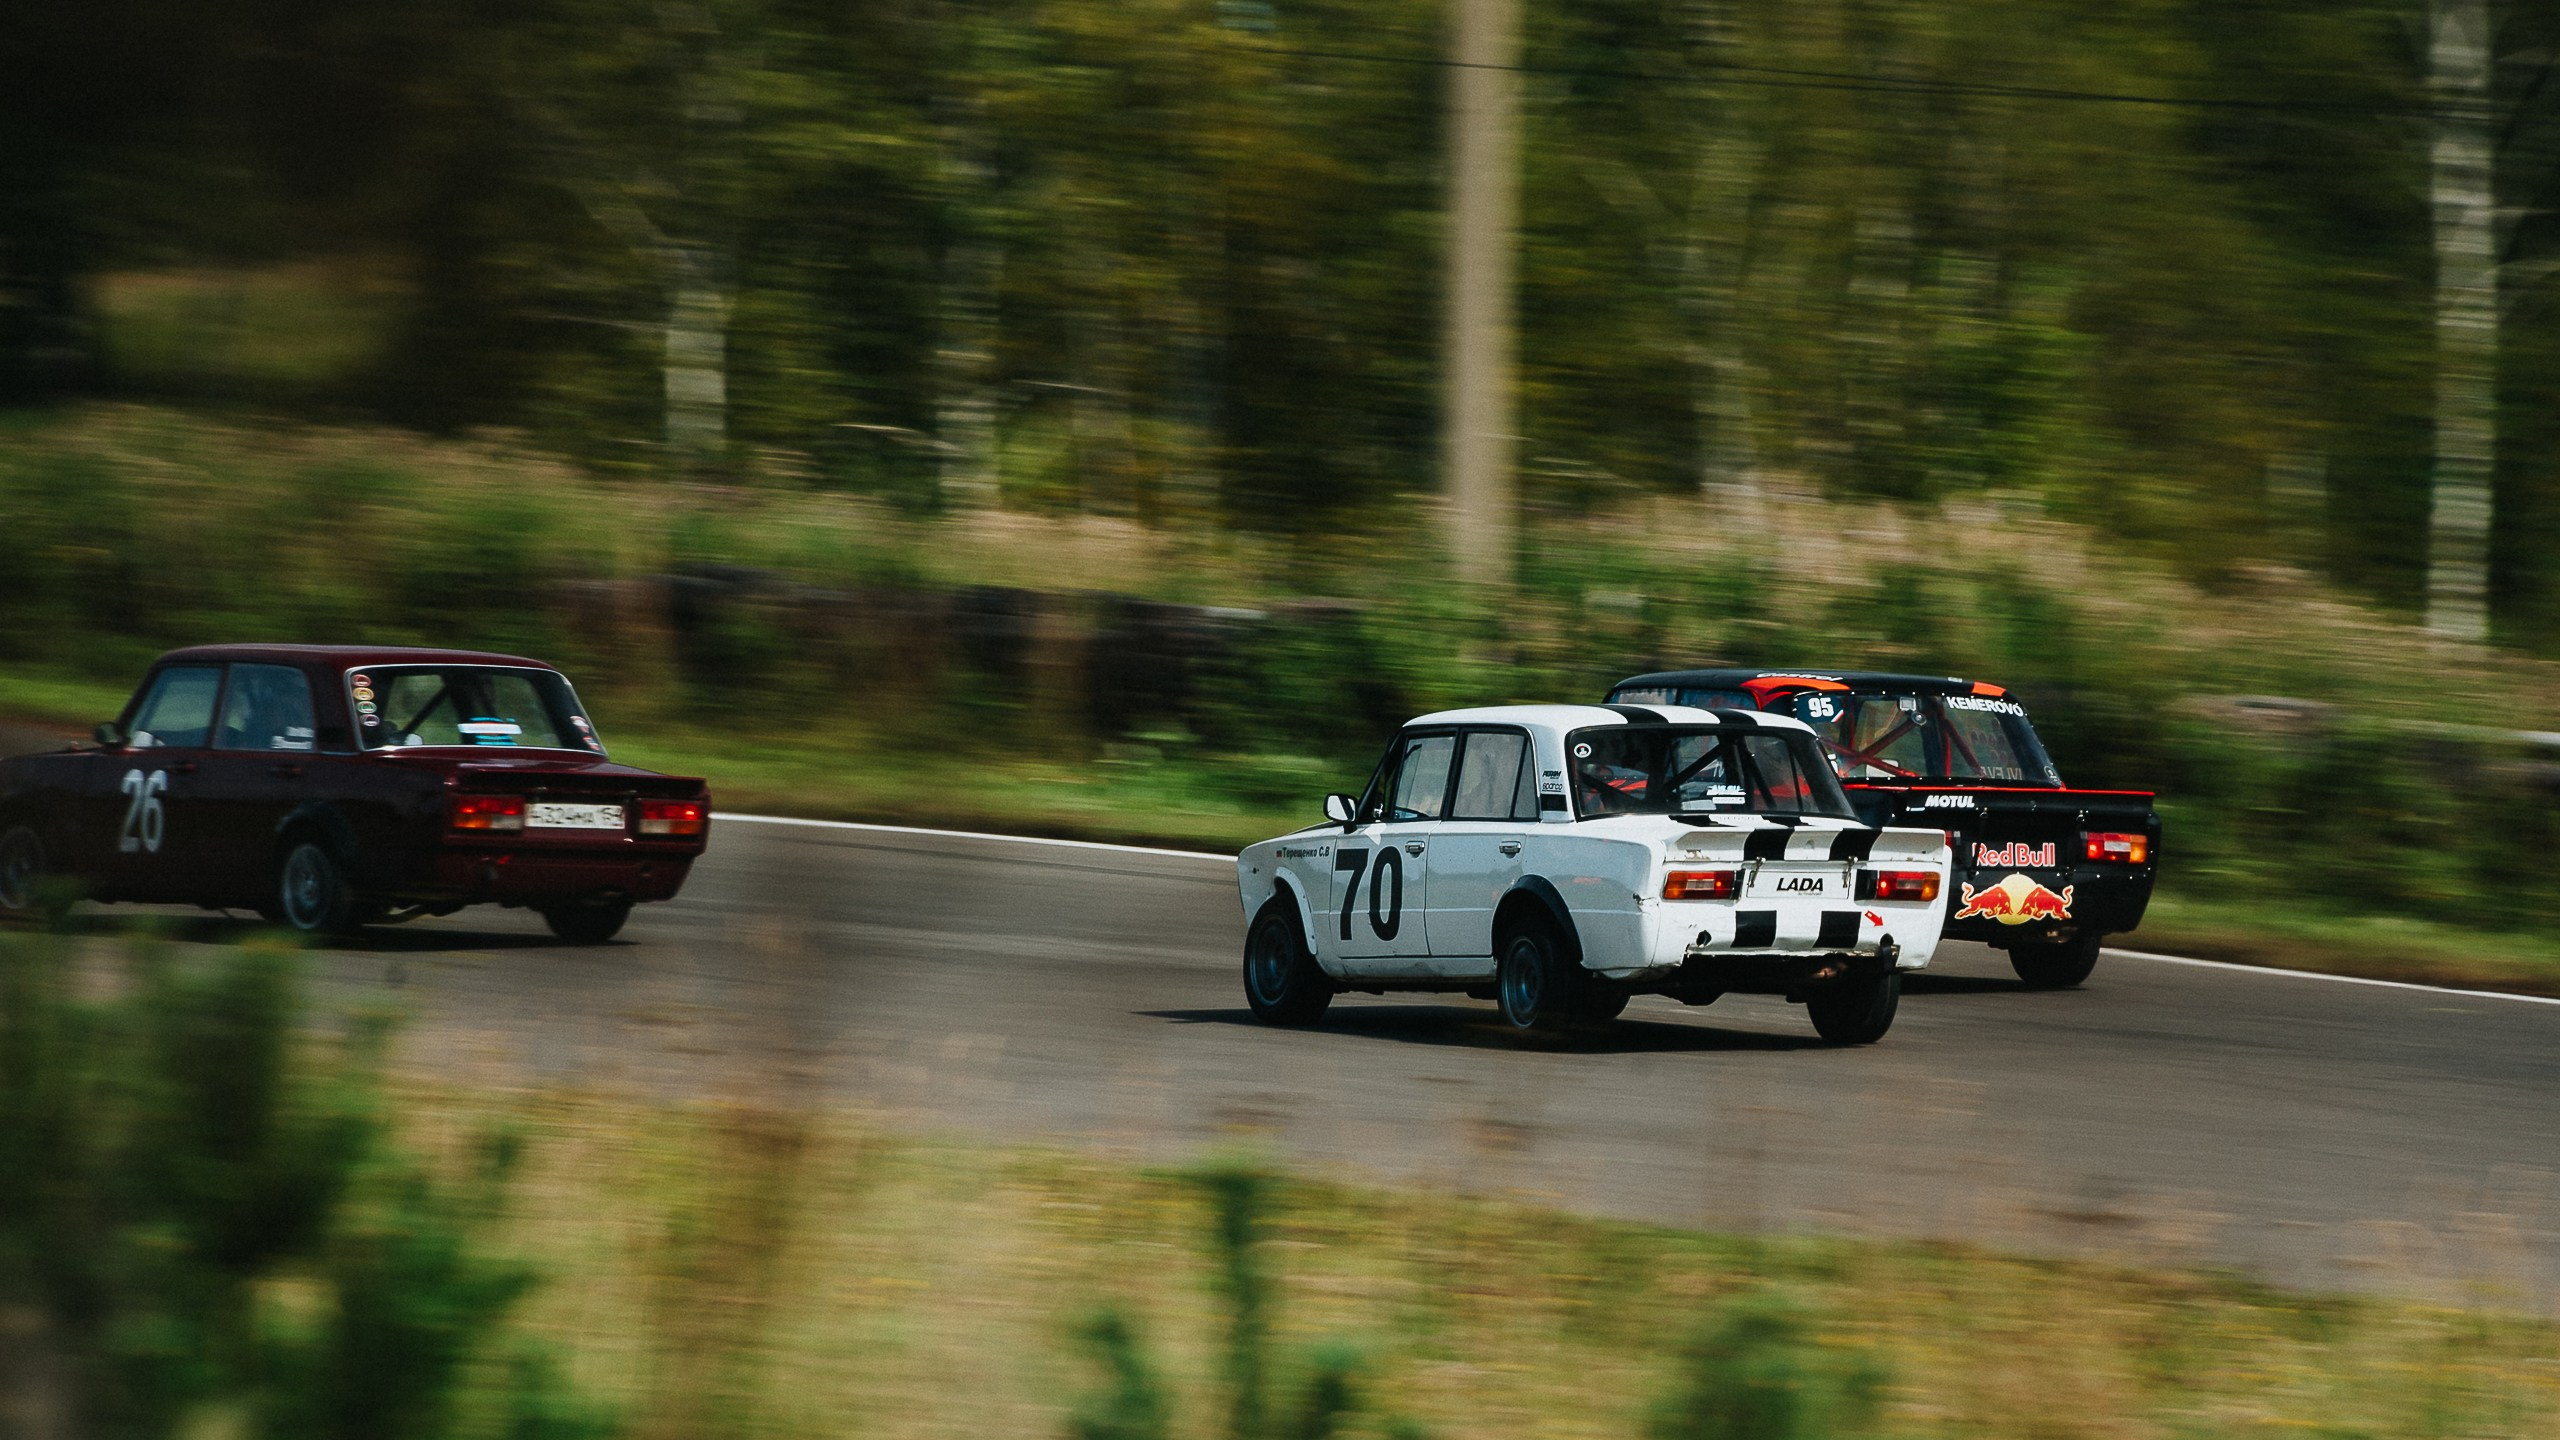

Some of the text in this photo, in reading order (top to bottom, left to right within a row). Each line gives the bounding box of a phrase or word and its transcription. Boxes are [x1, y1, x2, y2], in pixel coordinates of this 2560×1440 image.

[1808, 697, 1834, 718] 95
[1946, 696, 2024, 717] KEMEROVO
[120, 768, 167, 852] 26
[1925, 795, 1975, 808] MOTUL
[1972, 842, 2056, 867] Red Bull
[1335, 846, 1403, 942] 70
[1776, 877, 1824, 892] LADA
